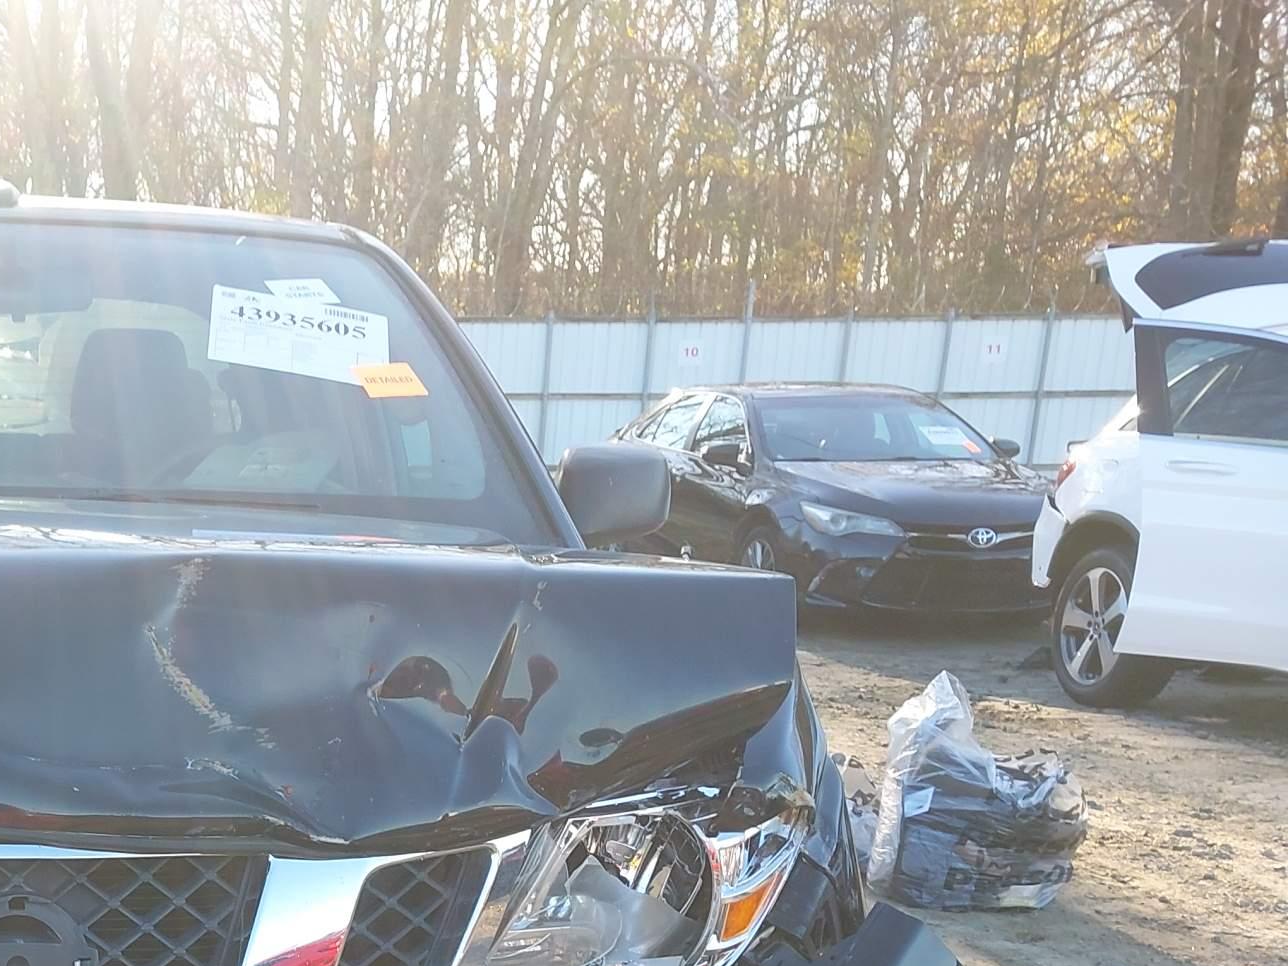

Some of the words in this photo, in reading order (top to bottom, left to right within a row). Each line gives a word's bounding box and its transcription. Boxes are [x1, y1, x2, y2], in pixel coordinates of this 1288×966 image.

[230, 306, 366, 340] 43935605
[684, 347, 699, 357] 10
[987, 344, 1001, 355] 11
[364, 375, 413, 384] DETAILED
